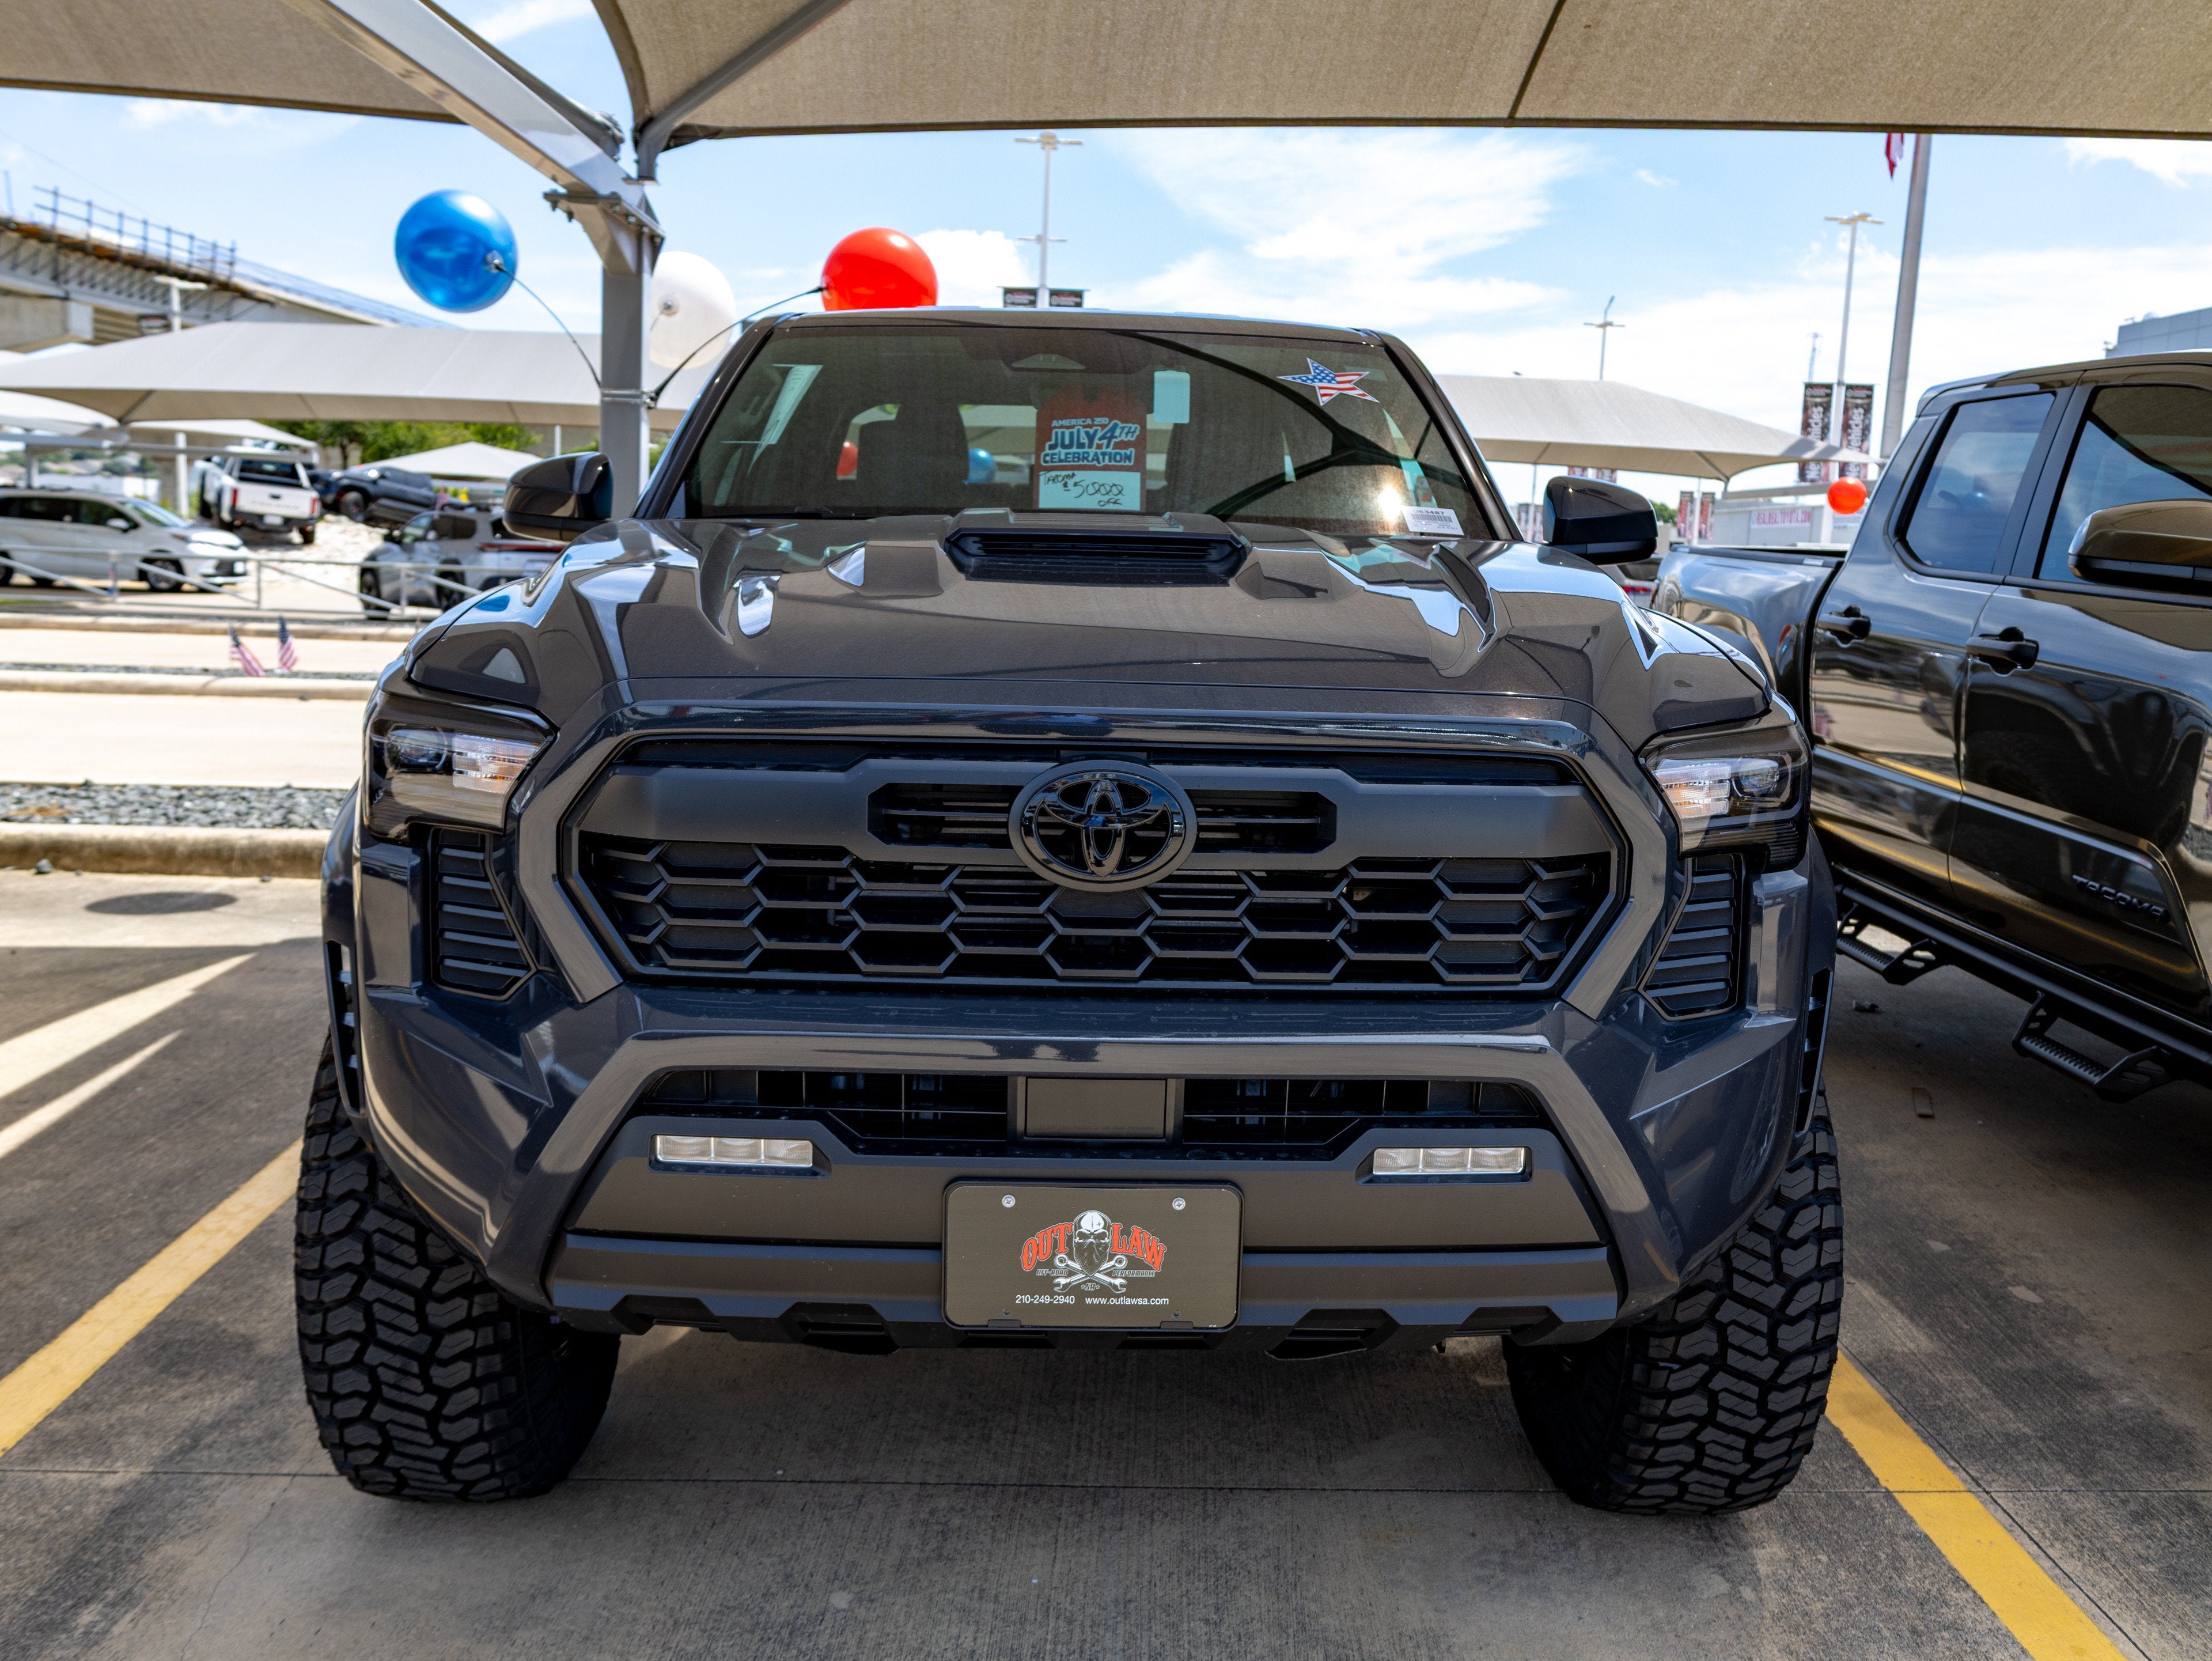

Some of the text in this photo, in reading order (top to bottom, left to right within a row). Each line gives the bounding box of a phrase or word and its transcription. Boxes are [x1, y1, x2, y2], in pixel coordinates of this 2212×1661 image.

[1051, 418, 1092, 427] AMERICA
[1047, 427, 1100, 451] JULY
[1042, 449, 1134, 464] CELEBRATION
[2073, 875, 2168, 921] TACOMA
[1085, 1282, 1096, 1291] SA
[1016, 1295, 1169, 1305] 210-249-2940 www.outlawsa.com
